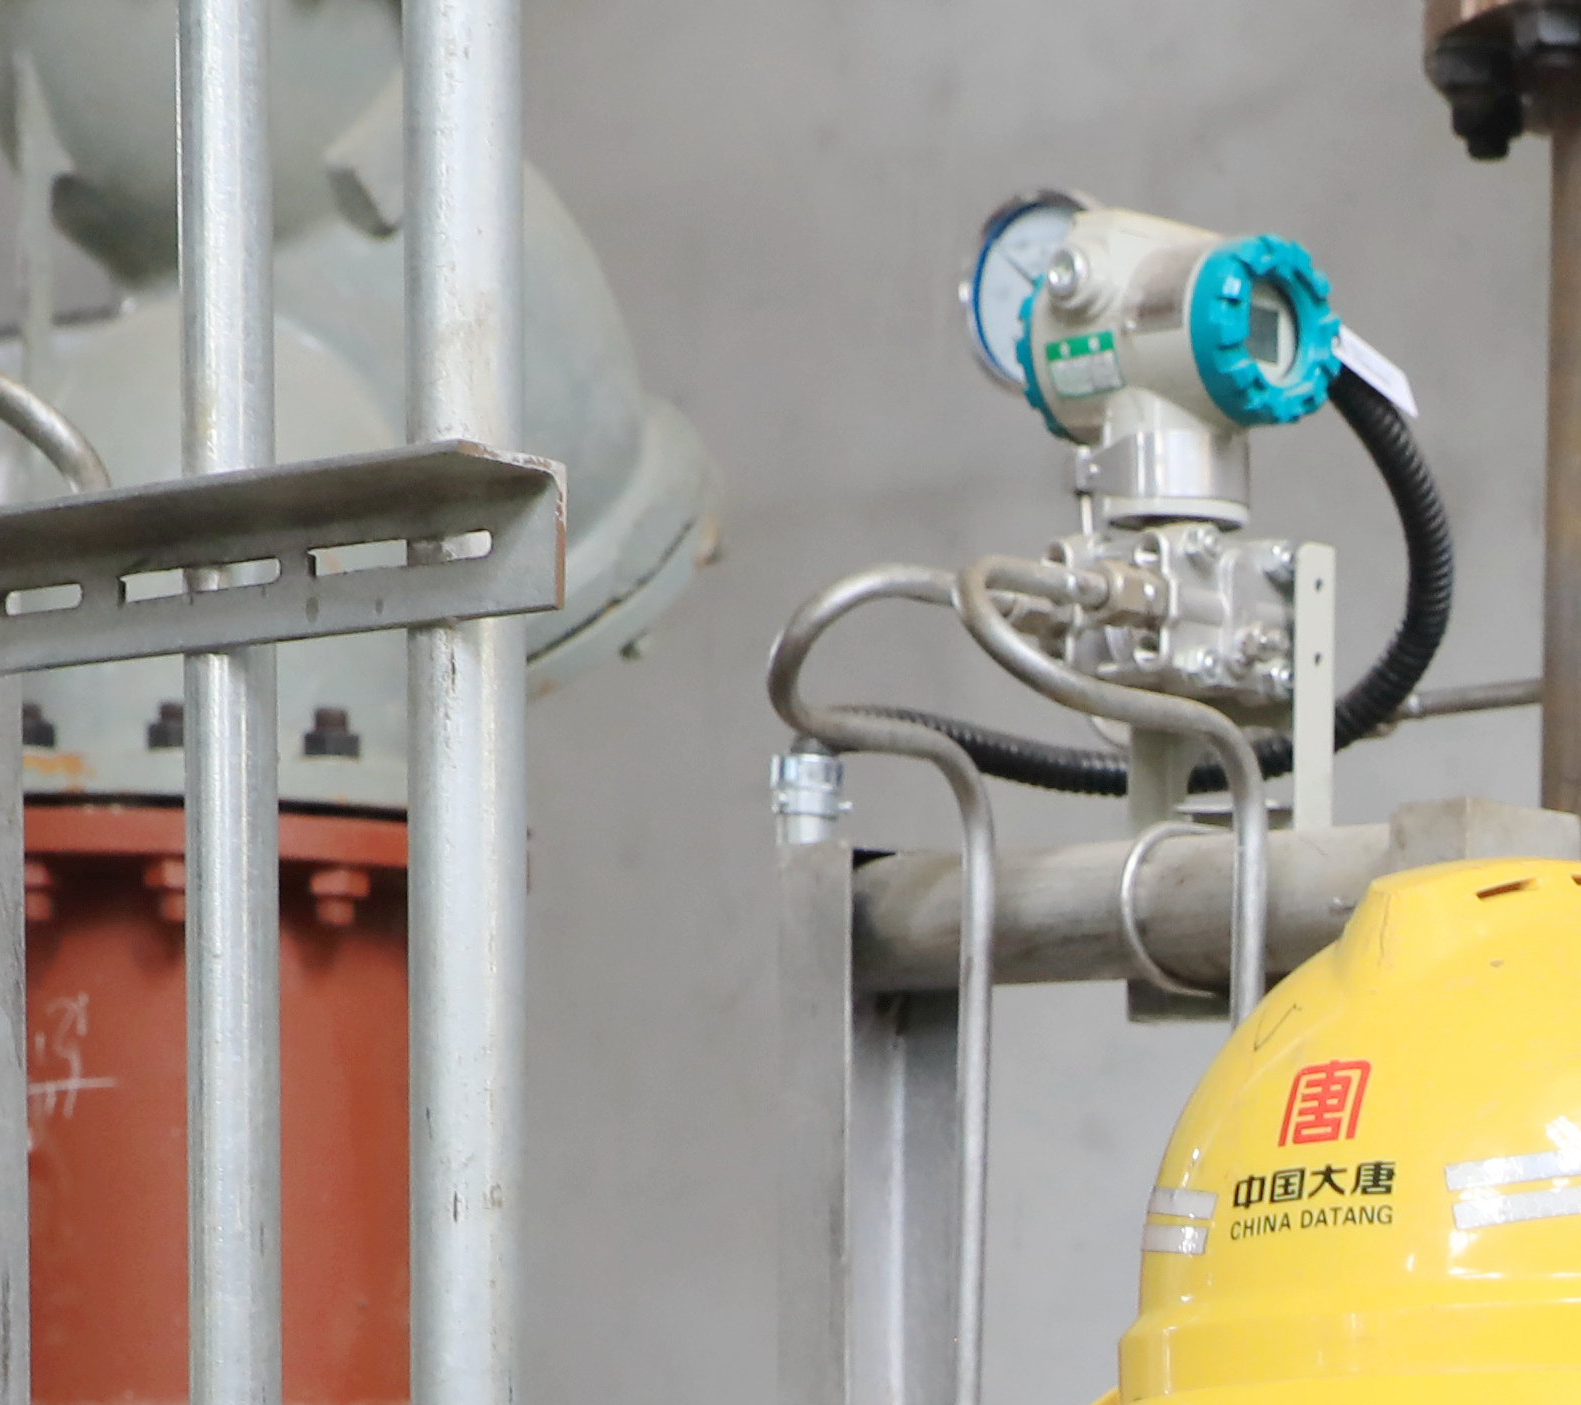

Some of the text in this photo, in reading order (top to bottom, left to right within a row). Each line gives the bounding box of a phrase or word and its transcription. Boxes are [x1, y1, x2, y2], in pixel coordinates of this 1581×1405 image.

[1233, 1161, 1395, 1209] 中国大唐
[1230, 1205, 1394, 1240] CHINA DATANG
